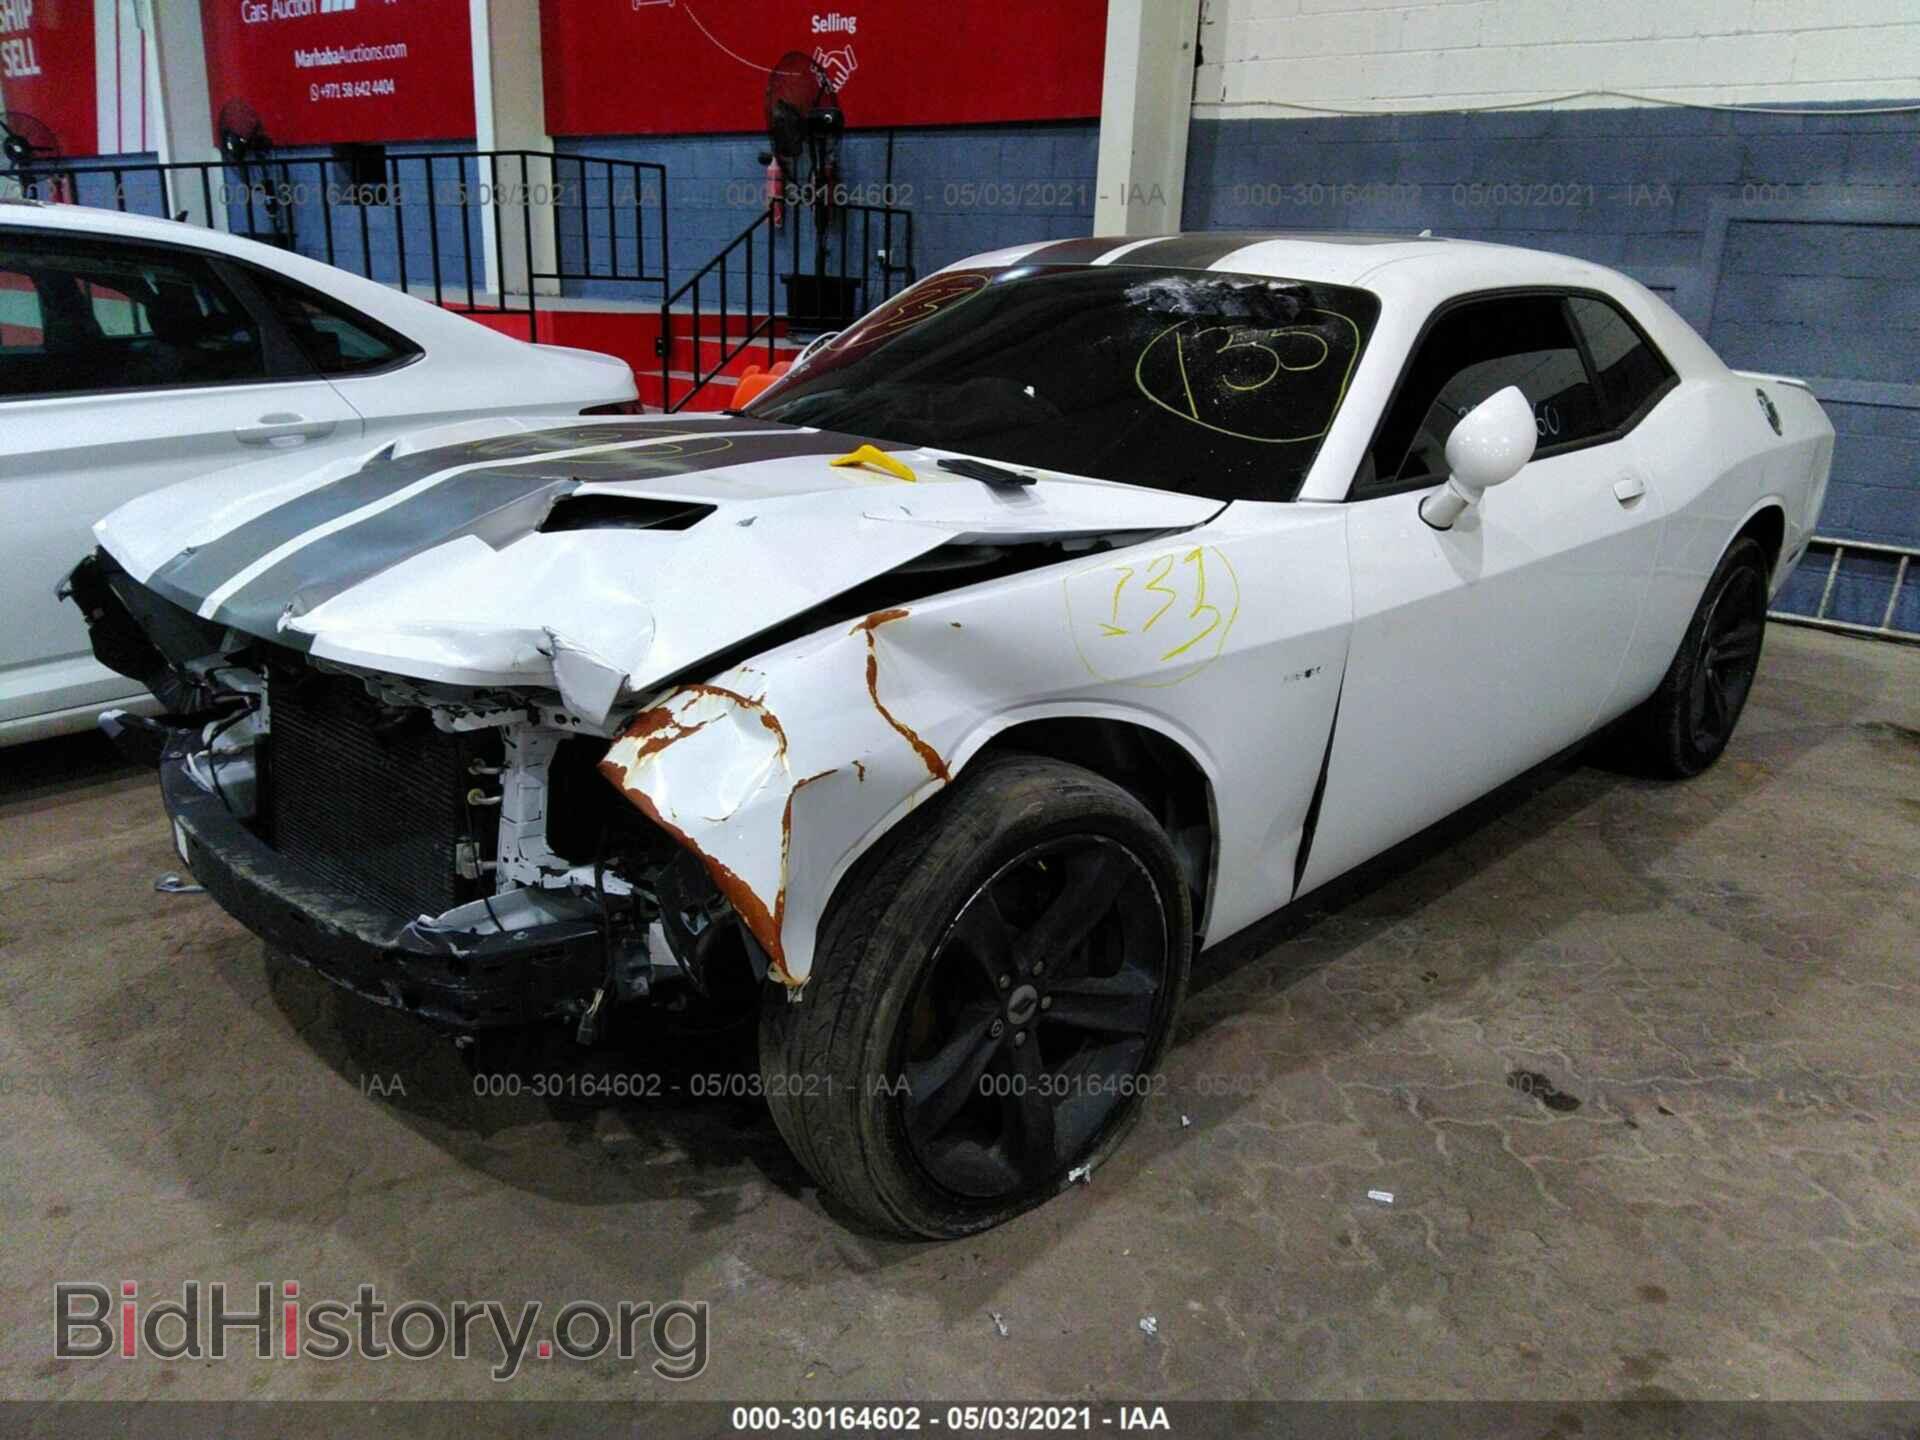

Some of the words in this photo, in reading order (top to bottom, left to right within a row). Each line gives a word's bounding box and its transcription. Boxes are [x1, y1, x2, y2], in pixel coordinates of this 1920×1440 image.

[241, 0, 269, 23] Cars
[271, 0, 317, 20] Auction
[811, 13, 857, 34] Selling
[1, 37, 41, 77] SELL
[295, 43, 407, 69] MarhabaAuctions.com
[321, 83, 340, 98] +971
[355, 81, 371, 96] 642
